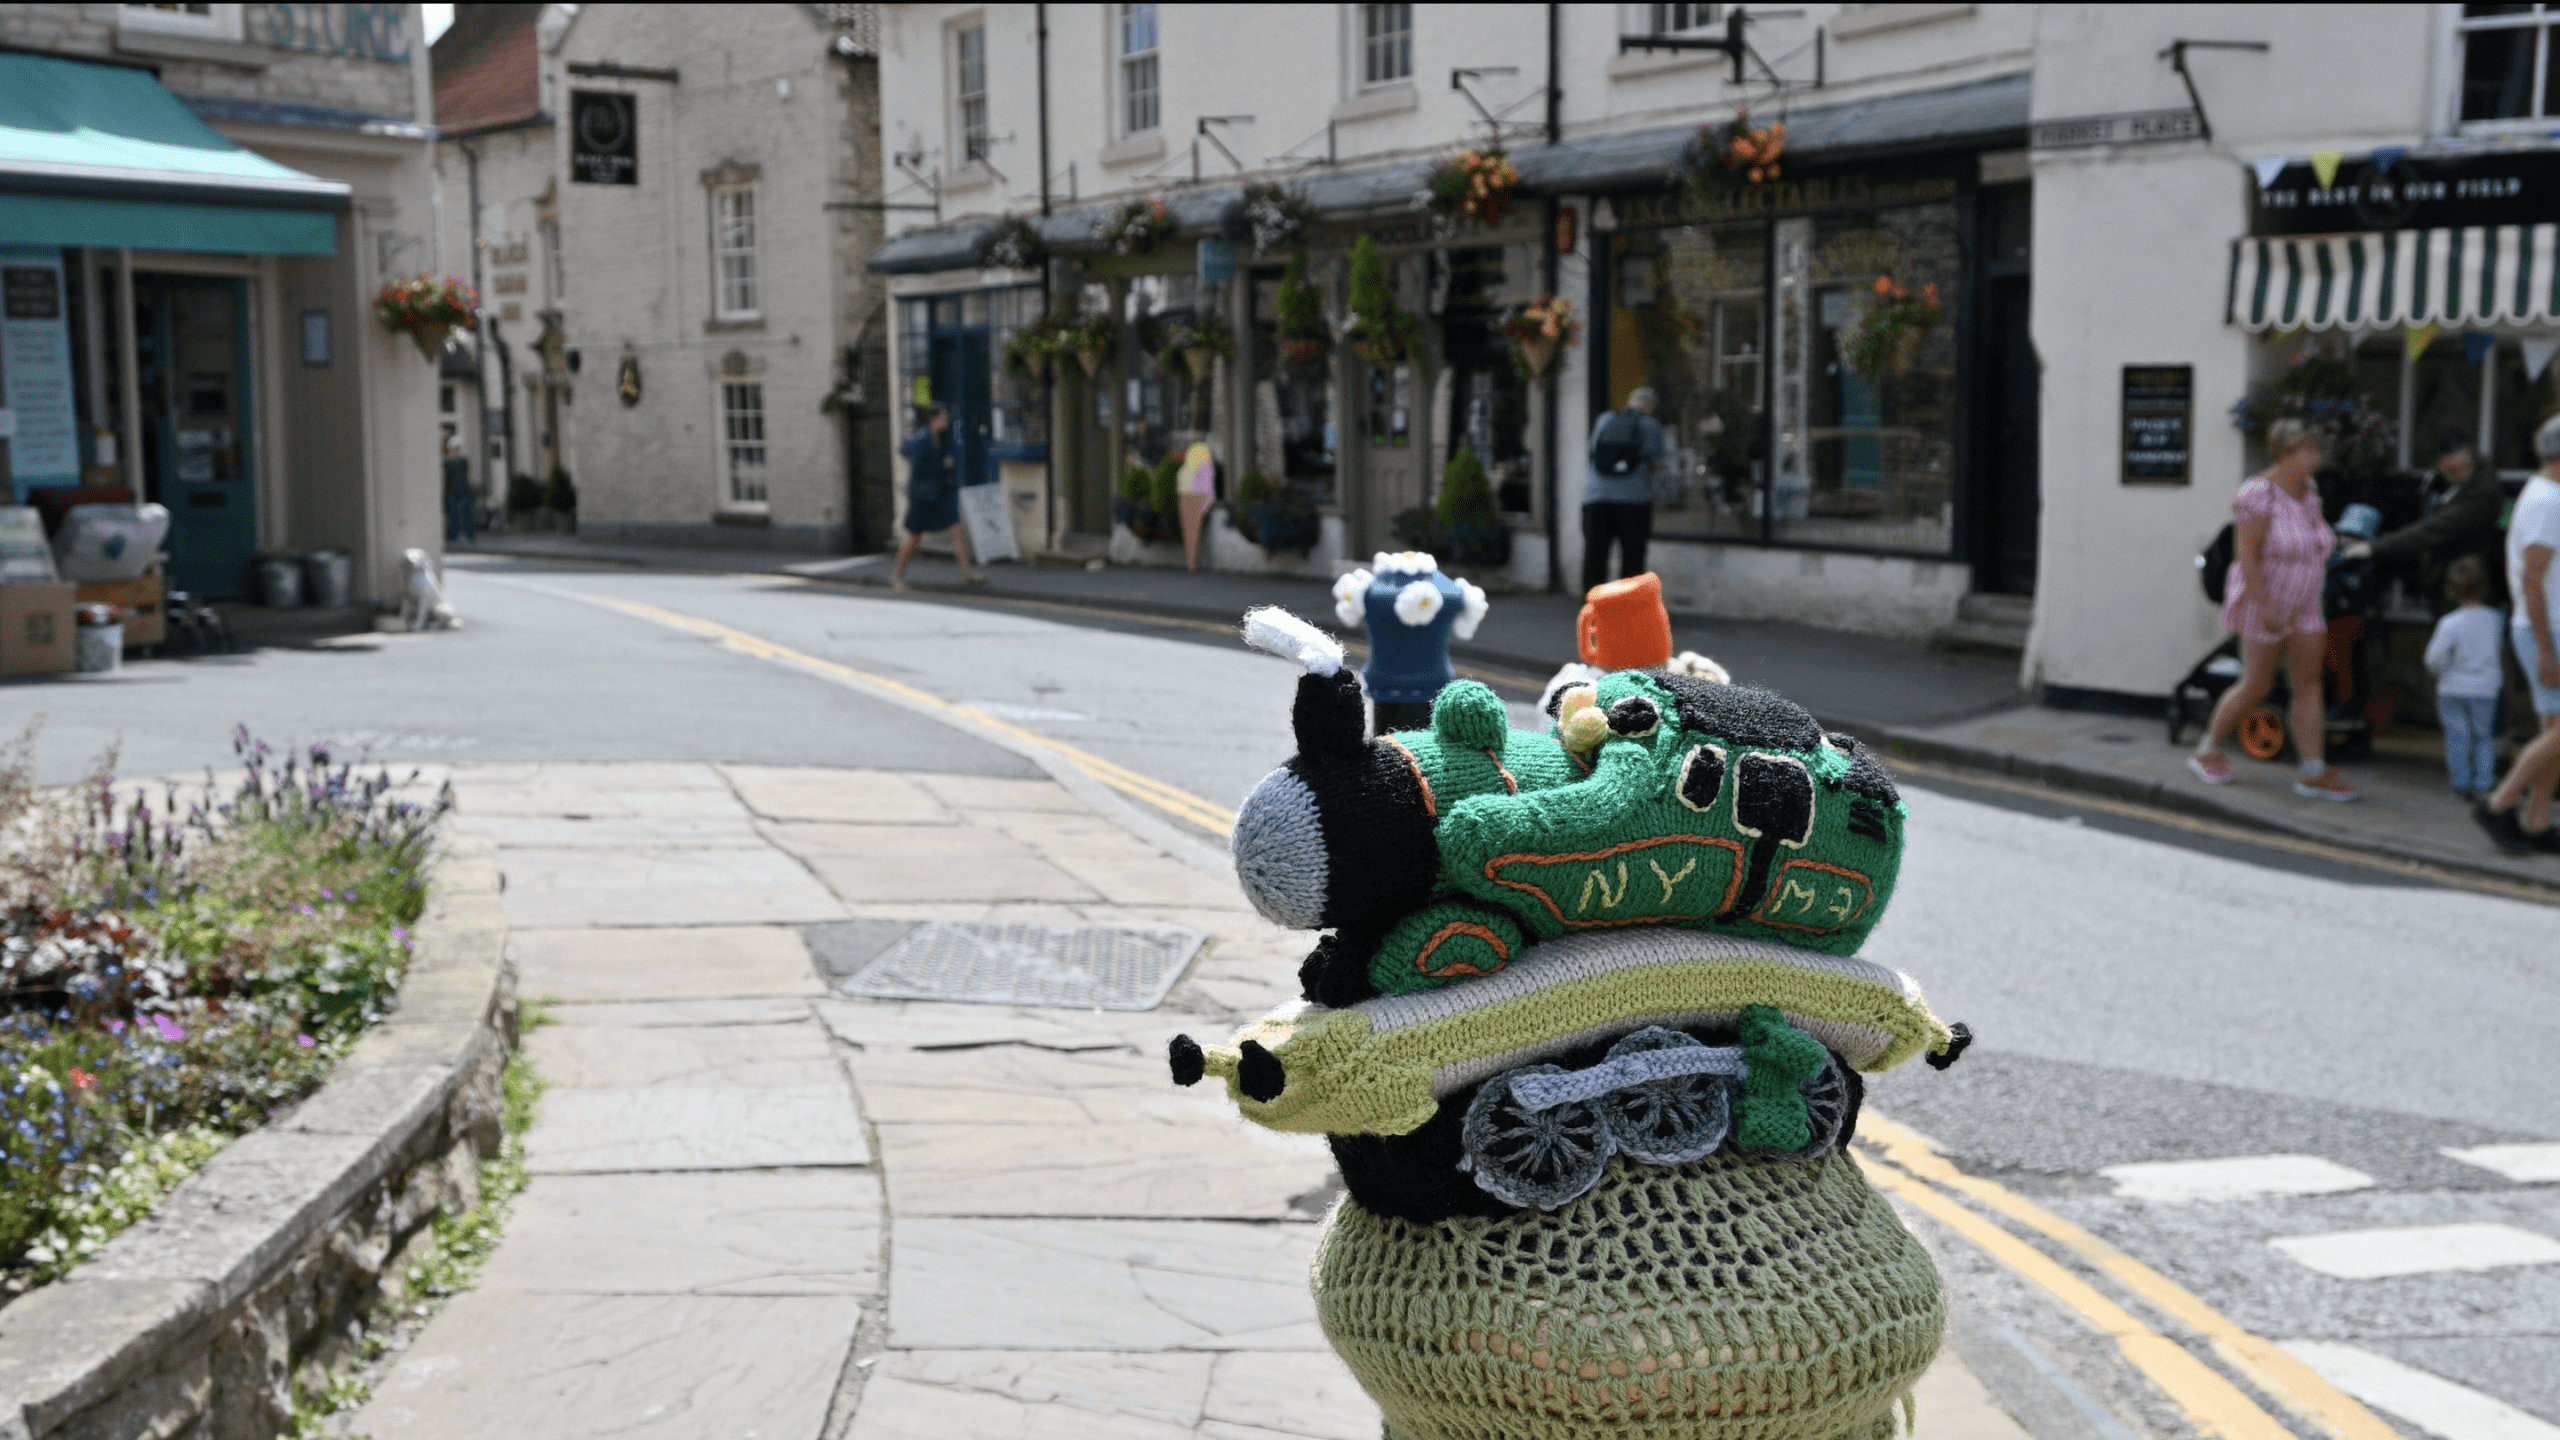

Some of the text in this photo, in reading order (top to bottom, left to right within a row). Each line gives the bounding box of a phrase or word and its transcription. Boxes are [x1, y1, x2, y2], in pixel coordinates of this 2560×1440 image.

[2132, 115, 2194, 136] PLACE
[2261, 189, 2298, 208] THE
[2456, 177, 2522, 199] FIELD
